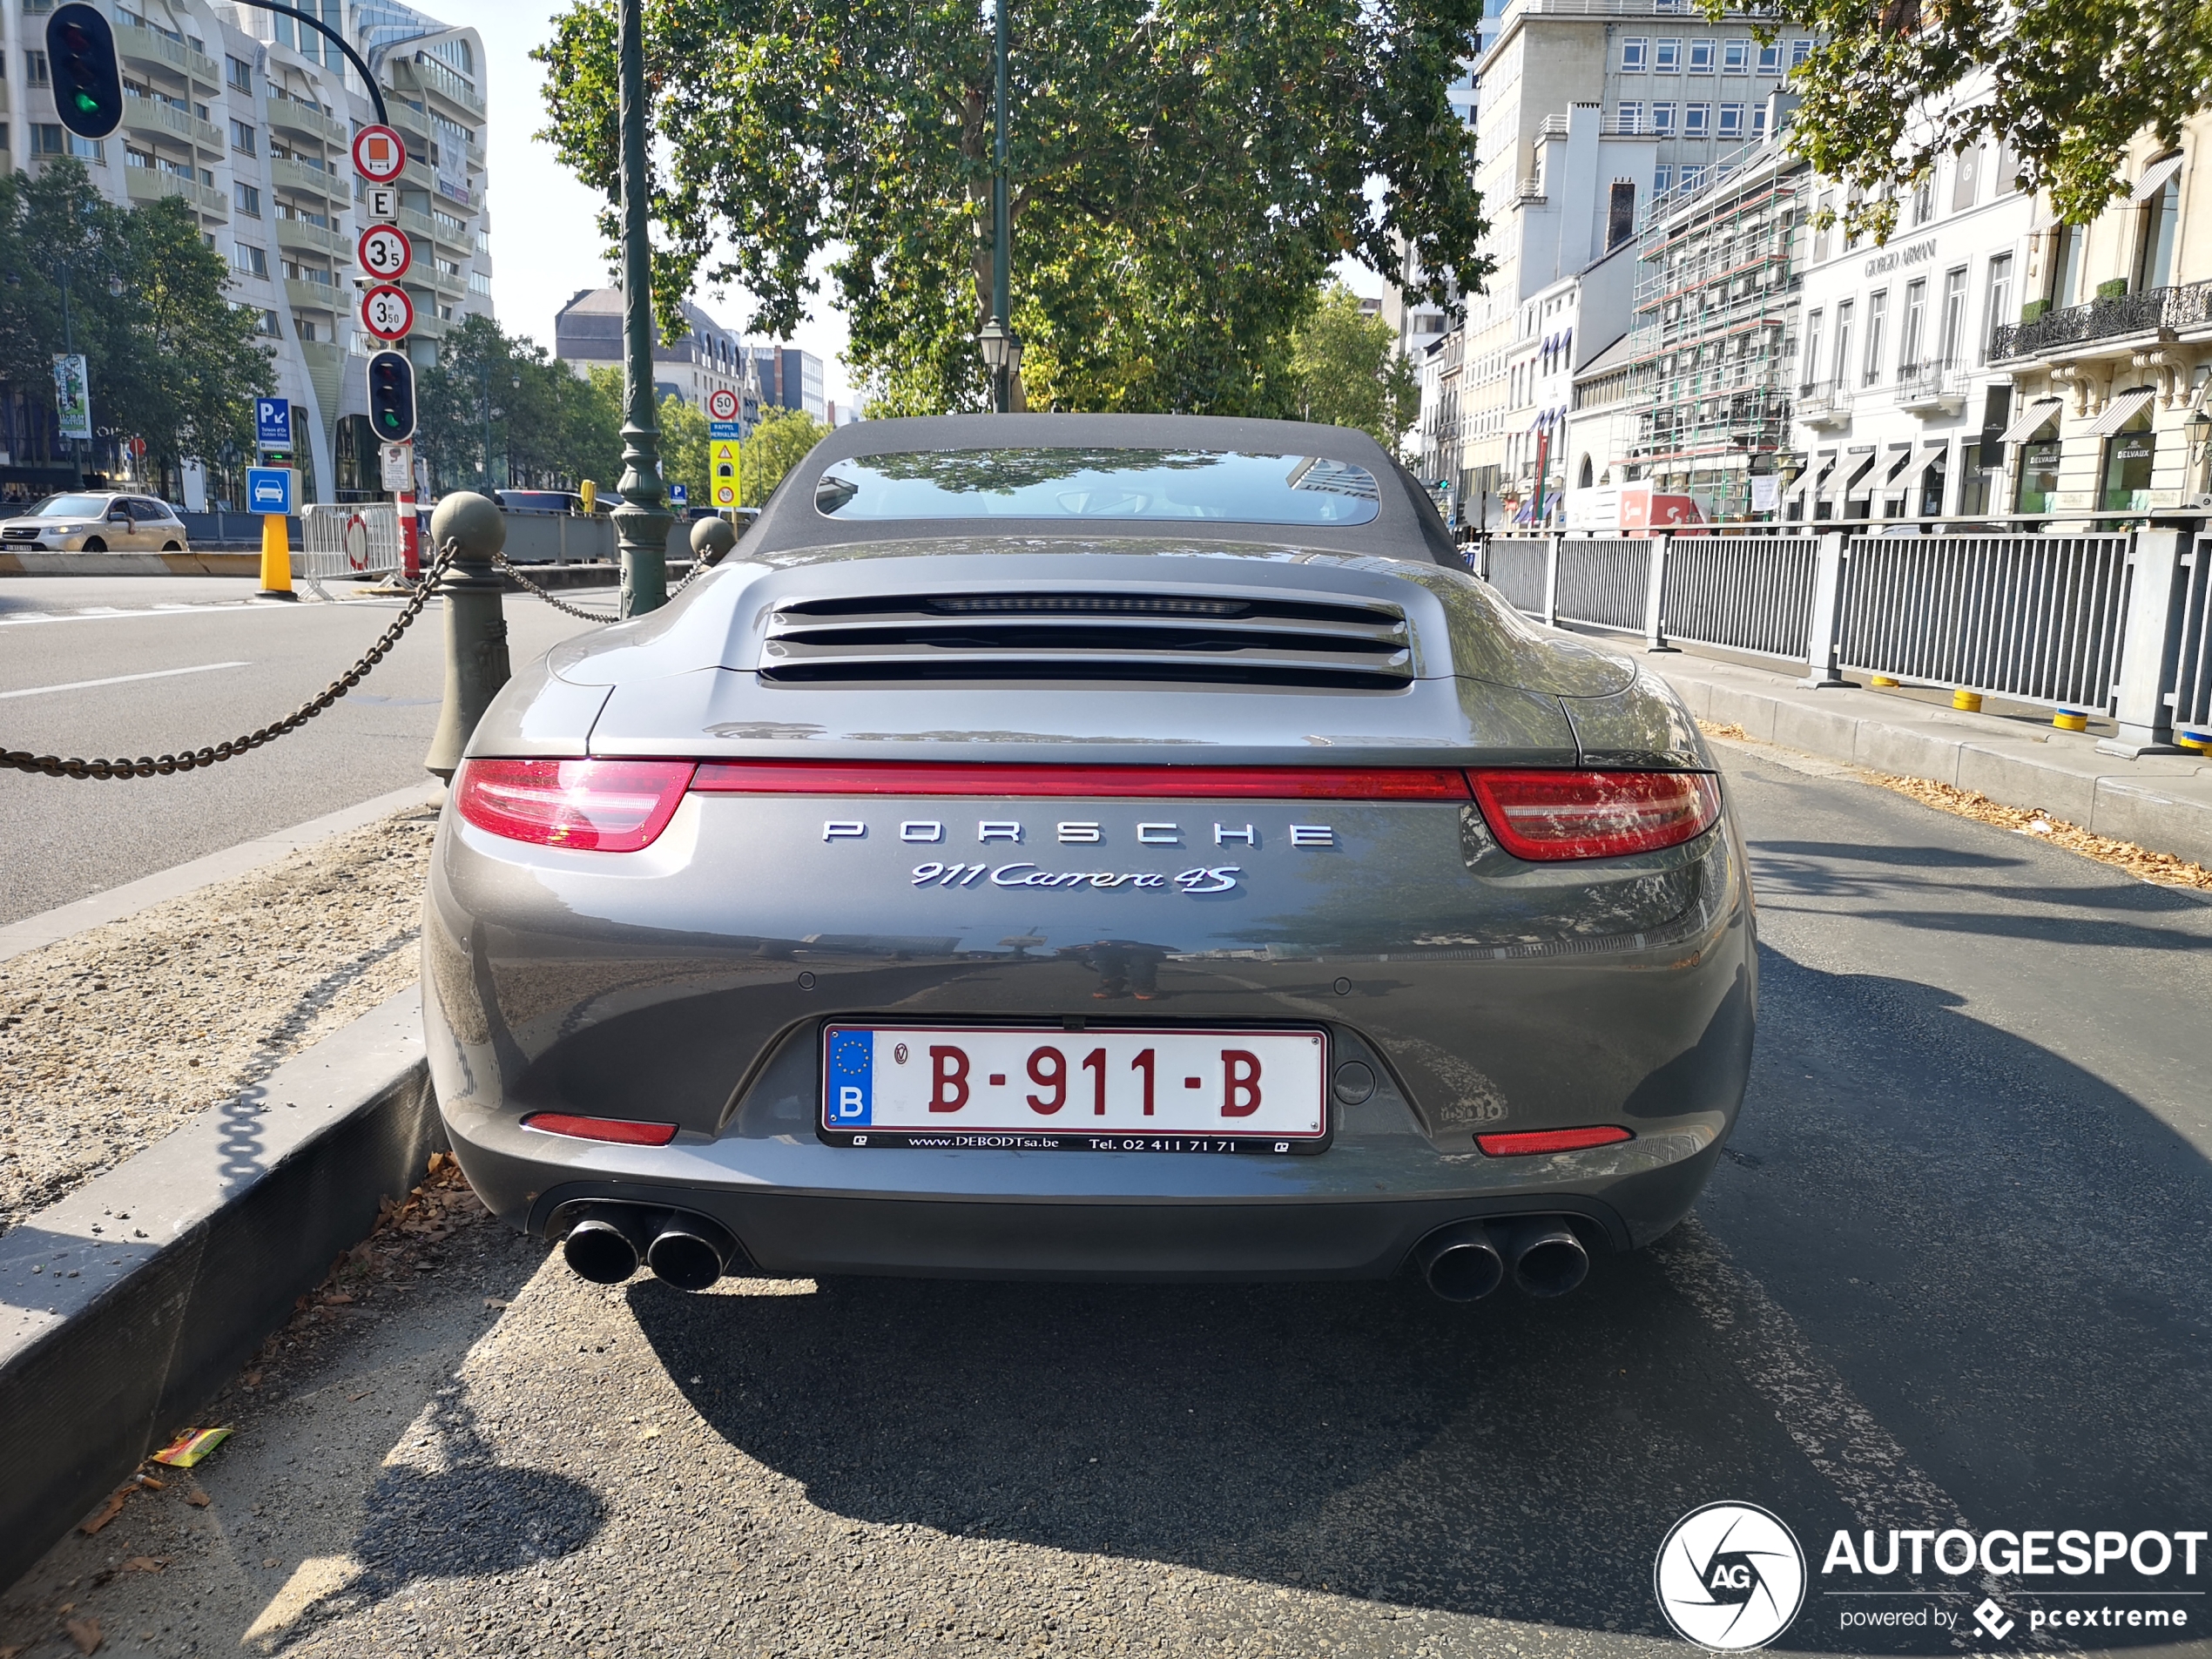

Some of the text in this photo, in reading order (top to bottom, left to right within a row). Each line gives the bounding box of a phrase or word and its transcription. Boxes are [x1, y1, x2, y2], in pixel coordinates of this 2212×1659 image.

[374, 192, 388, 214] E
[370, 239, 388, 266] 3
[1865, 238, 1937, 279] GIORGIO ARMANI
[376, 301, 388, 323] 3
[388, 314, 400, 324] 50
[59, 360, 68, 405] EXPERIENCE
[260, 402, 274, 423] P
[717, 397, 732, 408] 50
[2030, 455, 2058, 464] DELVAUX
[2117, 449, 2149, 459] DELVAUX
[674, 485, 682, 496] P
[822, 820, 1334, 846] PORSCHE
[911, 862, 1241, 893] 911 Carrera 4S
[928, 1045, 1262, 1117] B-911-B
[840, 1086, 863, 1117] B
[908, 1136, 1235, 1151] www.DEBODTsa.be Tel. 02 411 71 71
